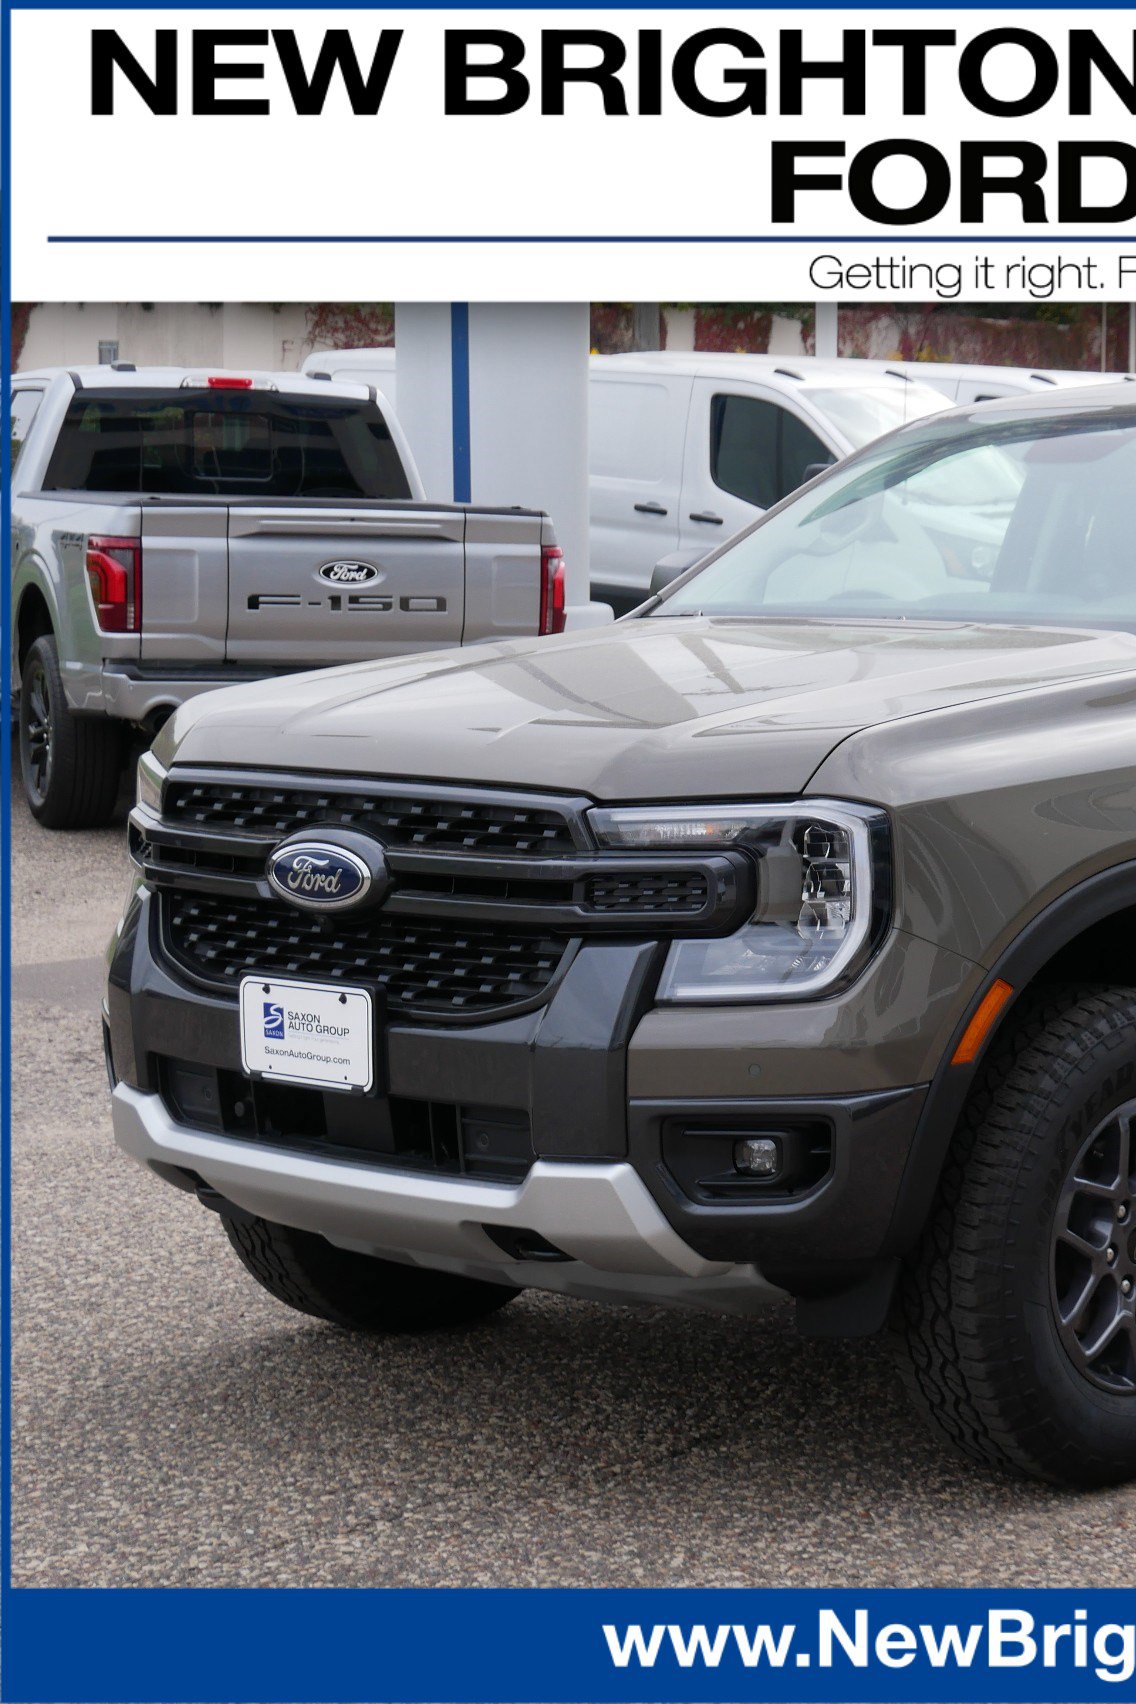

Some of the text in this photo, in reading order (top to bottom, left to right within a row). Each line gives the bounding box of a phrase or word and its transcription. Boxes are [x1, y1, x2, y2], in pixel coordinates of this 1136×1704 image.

[329, 563, 368, 582] Ford
[247, 594, 447, 612] F-150
[287, 855, 343, 893] Ford
[288, 1011, 321, 1023] SAXON
[288, 1021, 350, 1036] AUTO GROUP
[264, 1045, 351, 1065] SaxonAutoGroup.com
